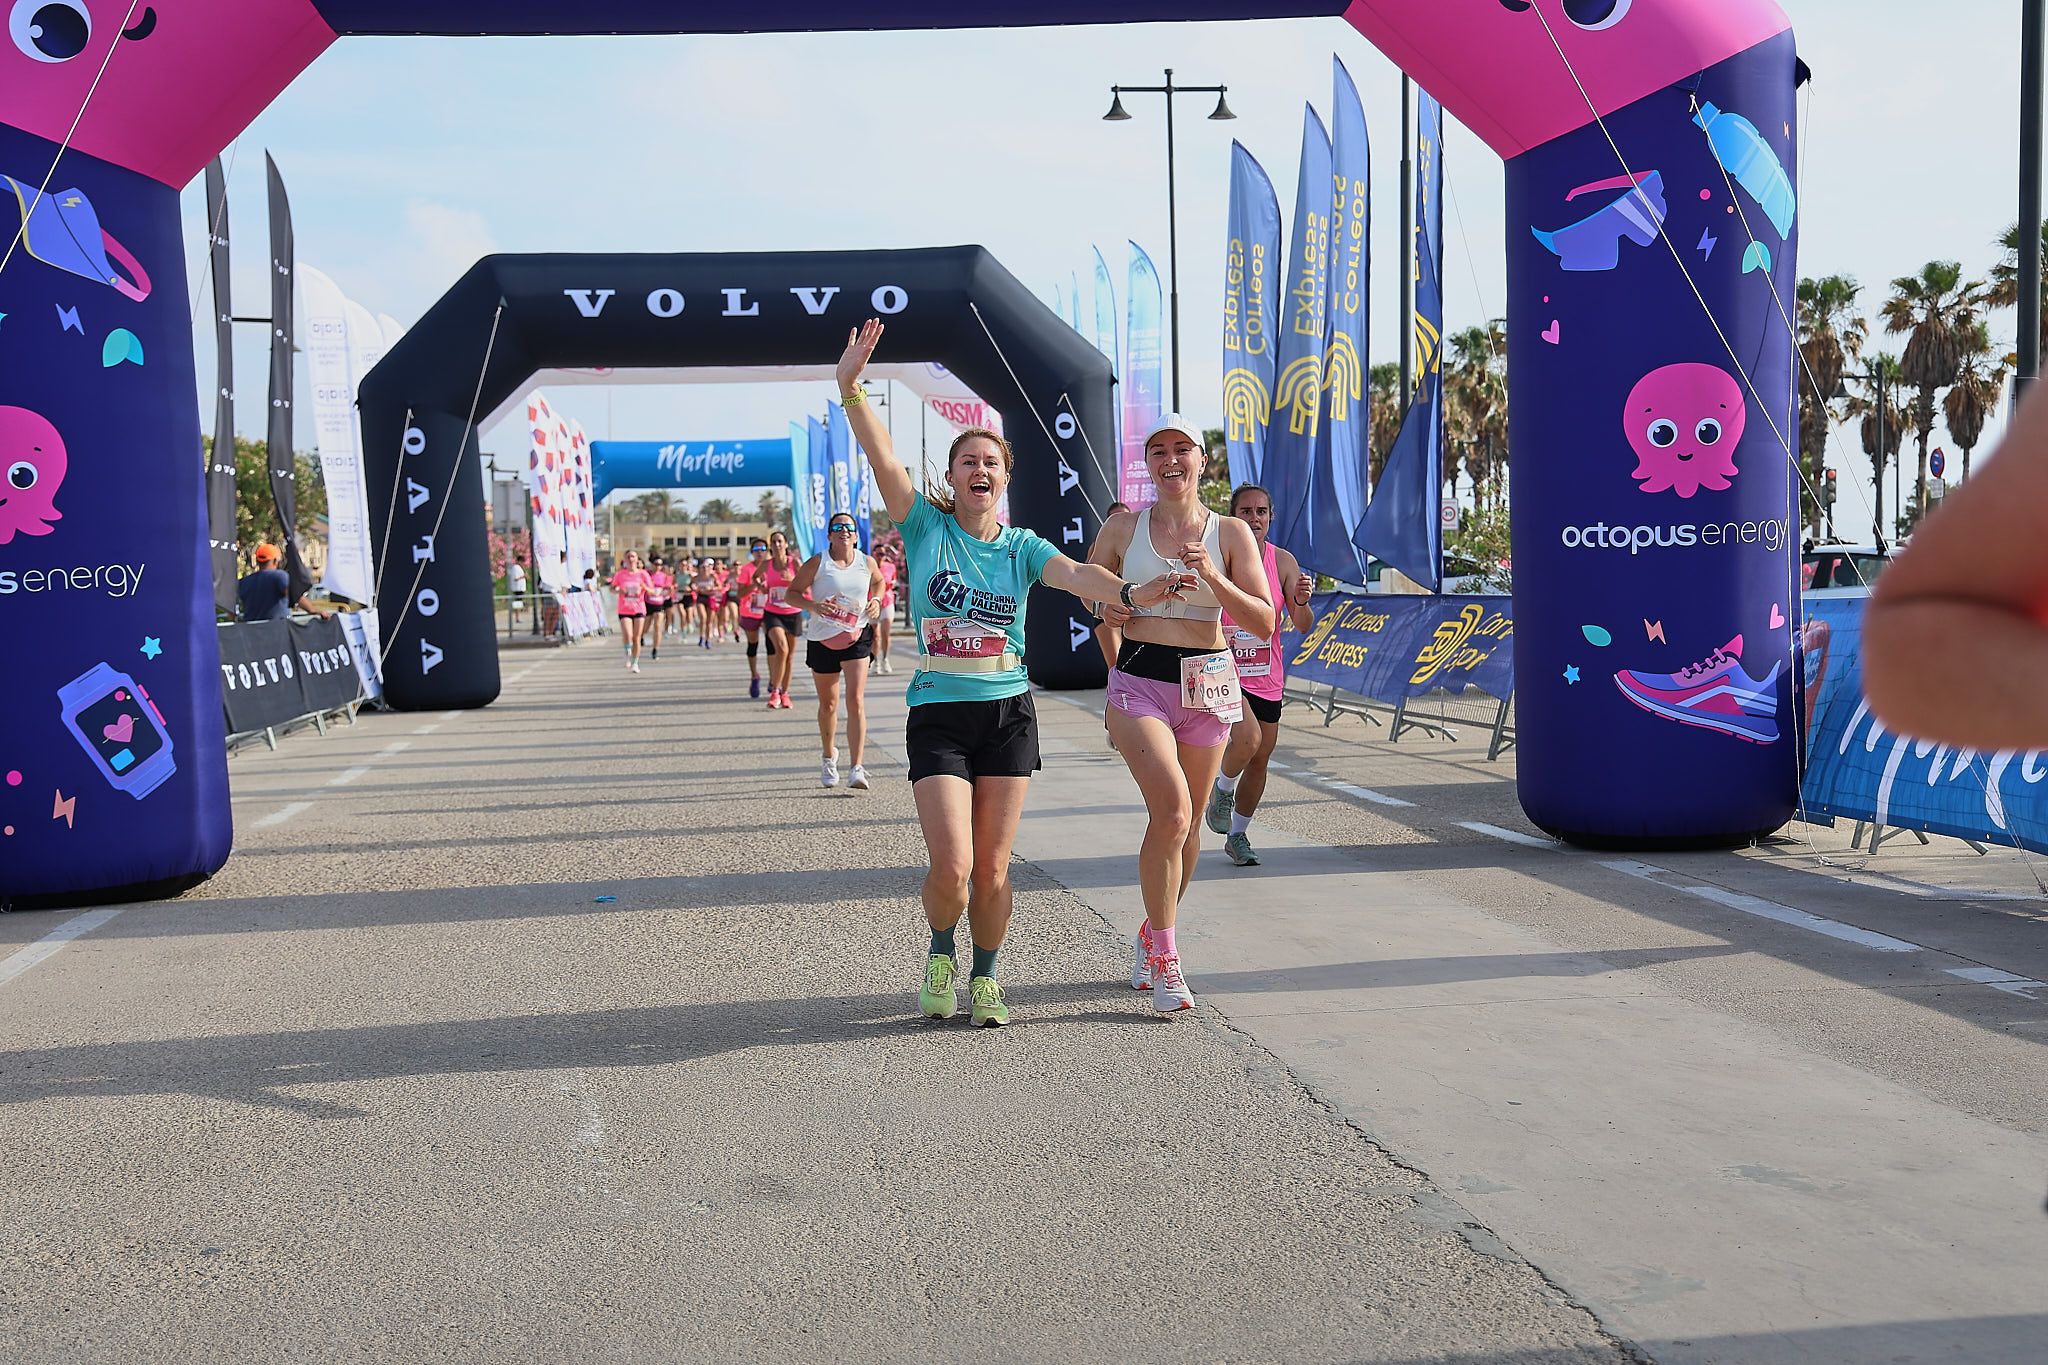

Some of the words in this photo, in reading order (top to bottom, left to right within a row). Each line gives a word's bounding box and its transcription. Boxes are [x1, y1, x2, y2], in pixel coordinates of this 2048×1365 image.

[563, 285, 909, 318] VOLVO
[656, 443, 744, 483] Marlene
[1054, 412, 1091, 652] VLVO
[1562, 522, 1697, 555] octopus
[1701, 518, 1788, 551] energy
[404, 427, 444, 676] VOLVO
[23, 563, 145, 598] energy
[971, 596, 1018, 614] VALENCIA
[1340, 605, 1391, 633] Correos
[1235, 648, 1257, 658] 016
[1317, 634, 1369, 670] Express
[221, 653, 294, 690] VOLVO
[1206, 684, 1230, 699] 016
